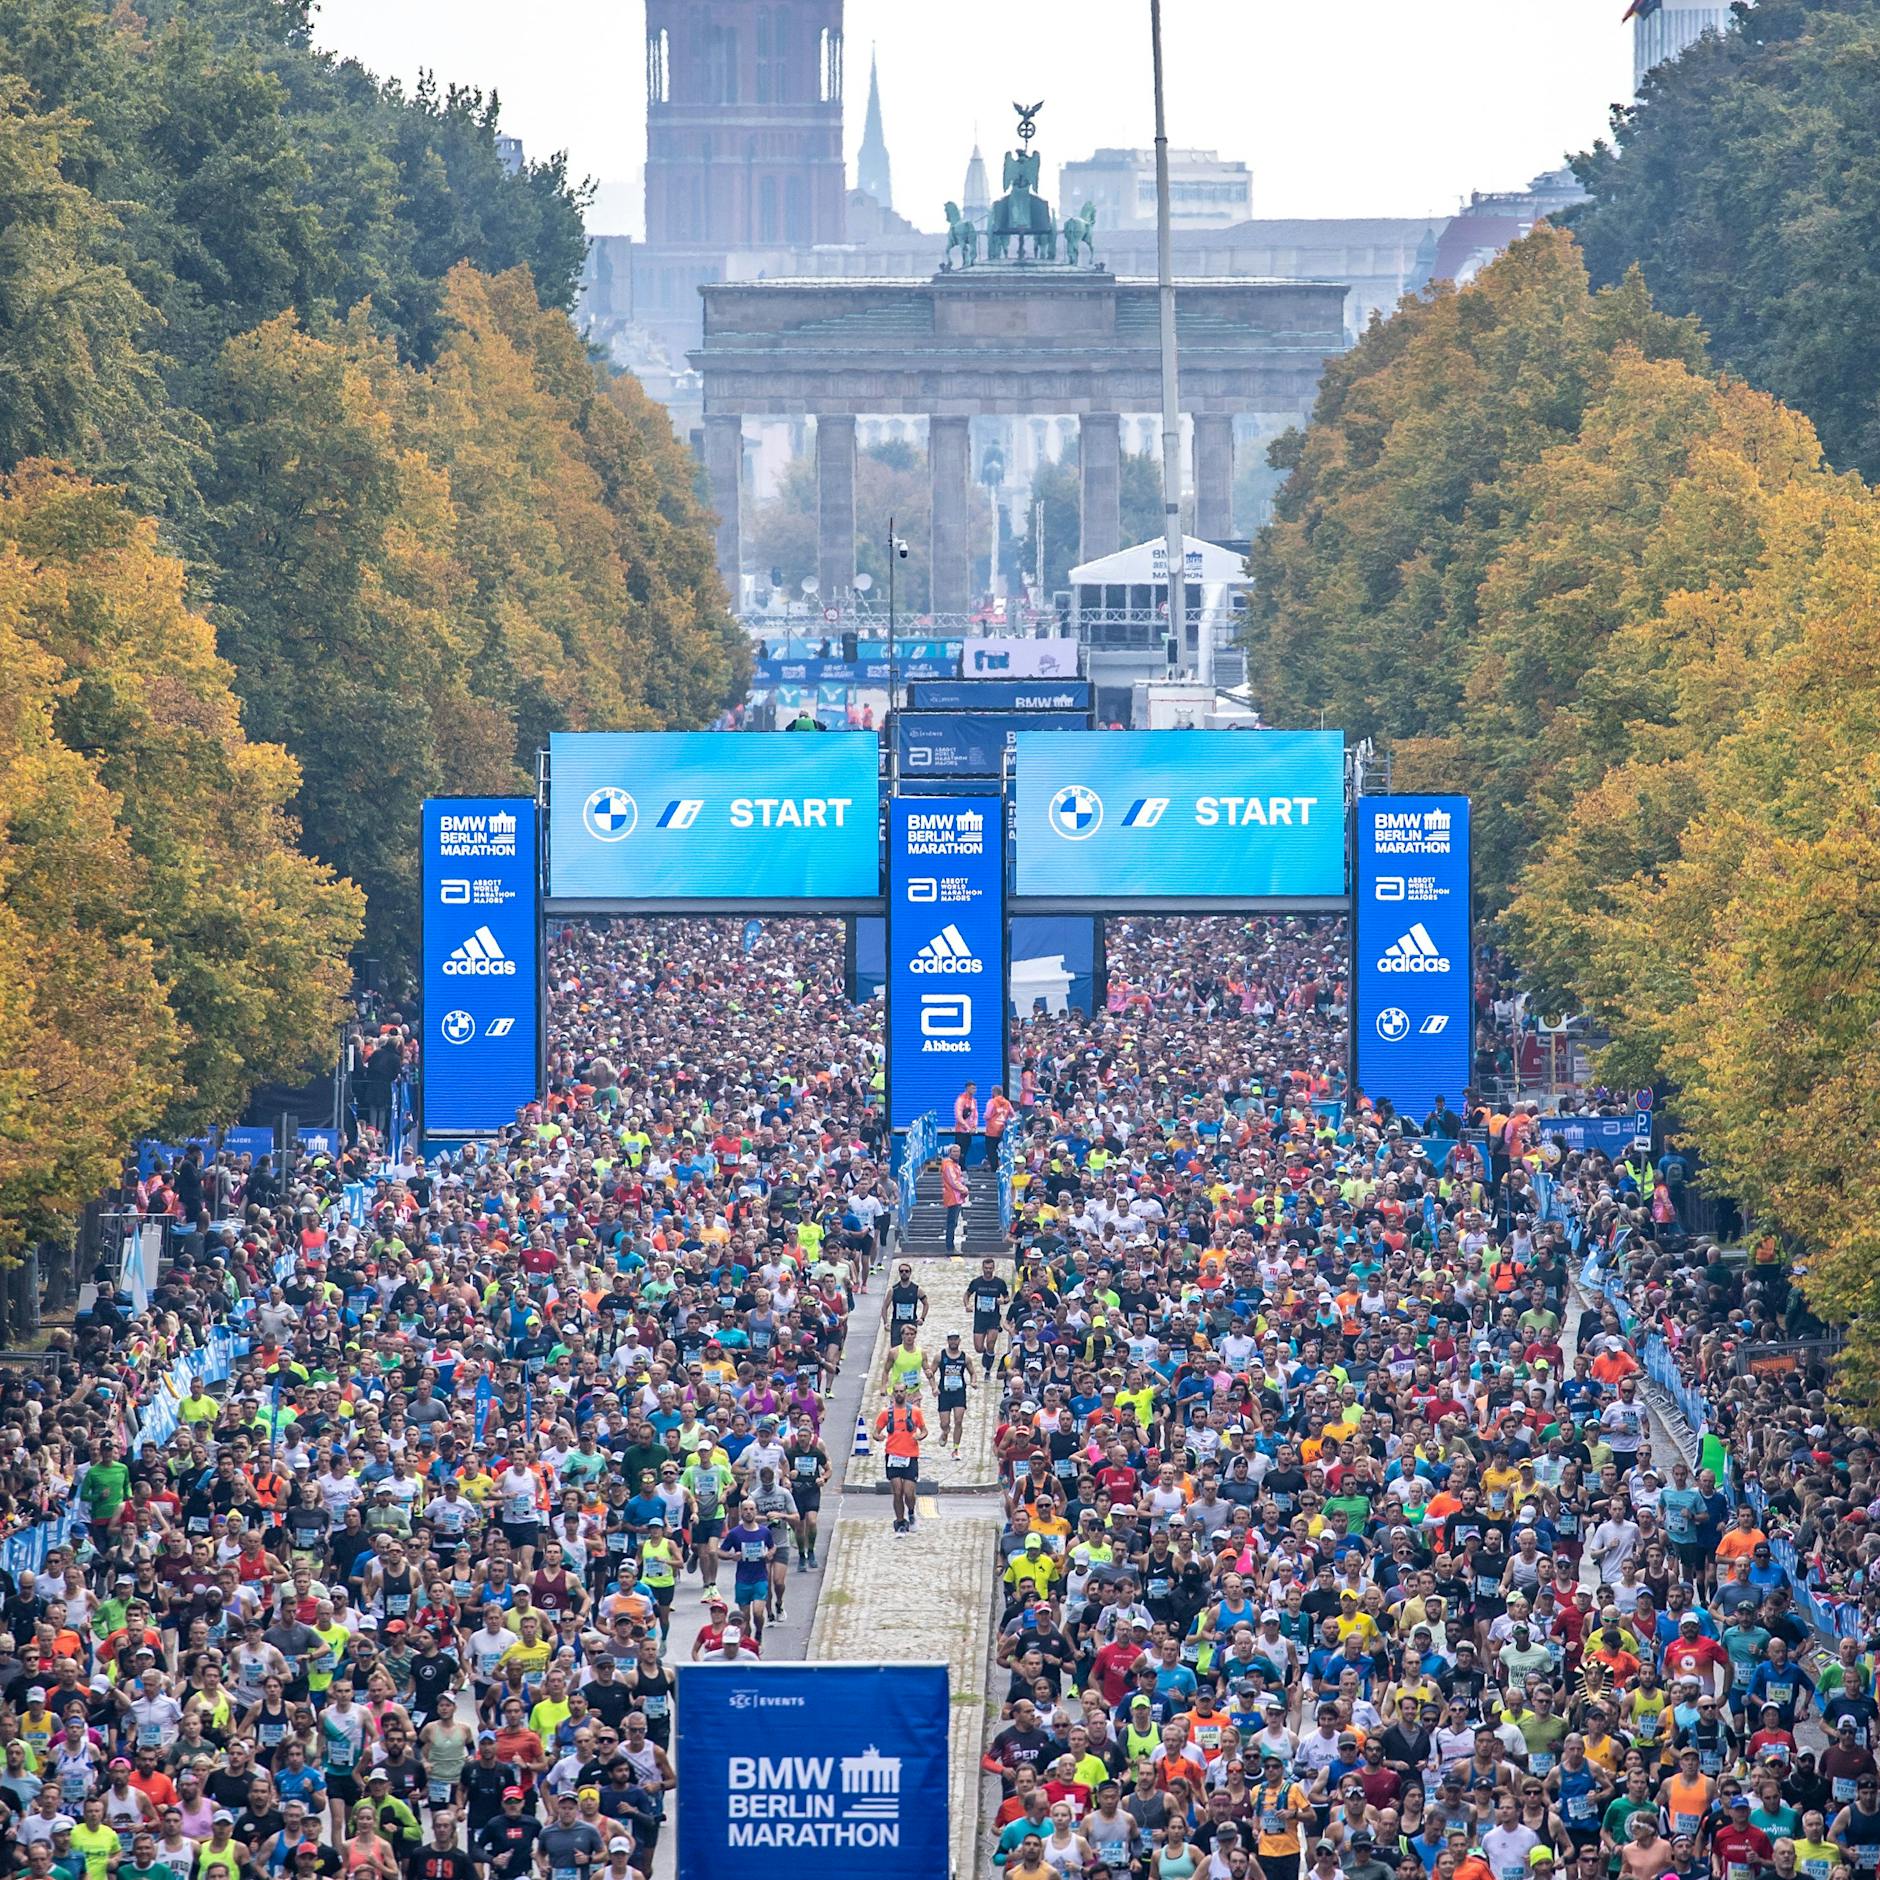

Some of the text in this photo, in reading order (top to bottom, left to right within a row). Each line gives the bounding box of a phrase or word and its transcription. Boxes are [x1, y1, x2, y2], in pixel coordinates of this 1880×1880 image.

[730, 798, 852, 828] START
[1195, 796, 1318, 826] START
[440, 816, 486, 831] BMW
[908, 814, 954, 830] BMW
[1375, 813, 1421, 829] BMW
[440, 832, 487, 844] BERLIN
[908, 831, 955, 842] BERLIN
[1375, 830, 1422, 841] BERLIN
[440, 845, 515, 856] MARATHON
[908, 843, 983, 854] MARATHON
[1375, 842, 1450, 853] MARATHON
[442, 957, 516, 975] adidas
[909, 955, 983, 974] adidas
[1377, 954, 1450, 972] adidas
[921, 1039, 971, 1052] Abbott
[1637, 1114, 1647, 1134] P
[729, 1694, 805, 1709] SCC EVENTS
[1014, 1749, 1039, 1761] PER
[729, 1757, 834, 1789] BMW
[729, 1795, 834, 1818] BERLIN
[728, 1823, 899, 1847] MARATHON
